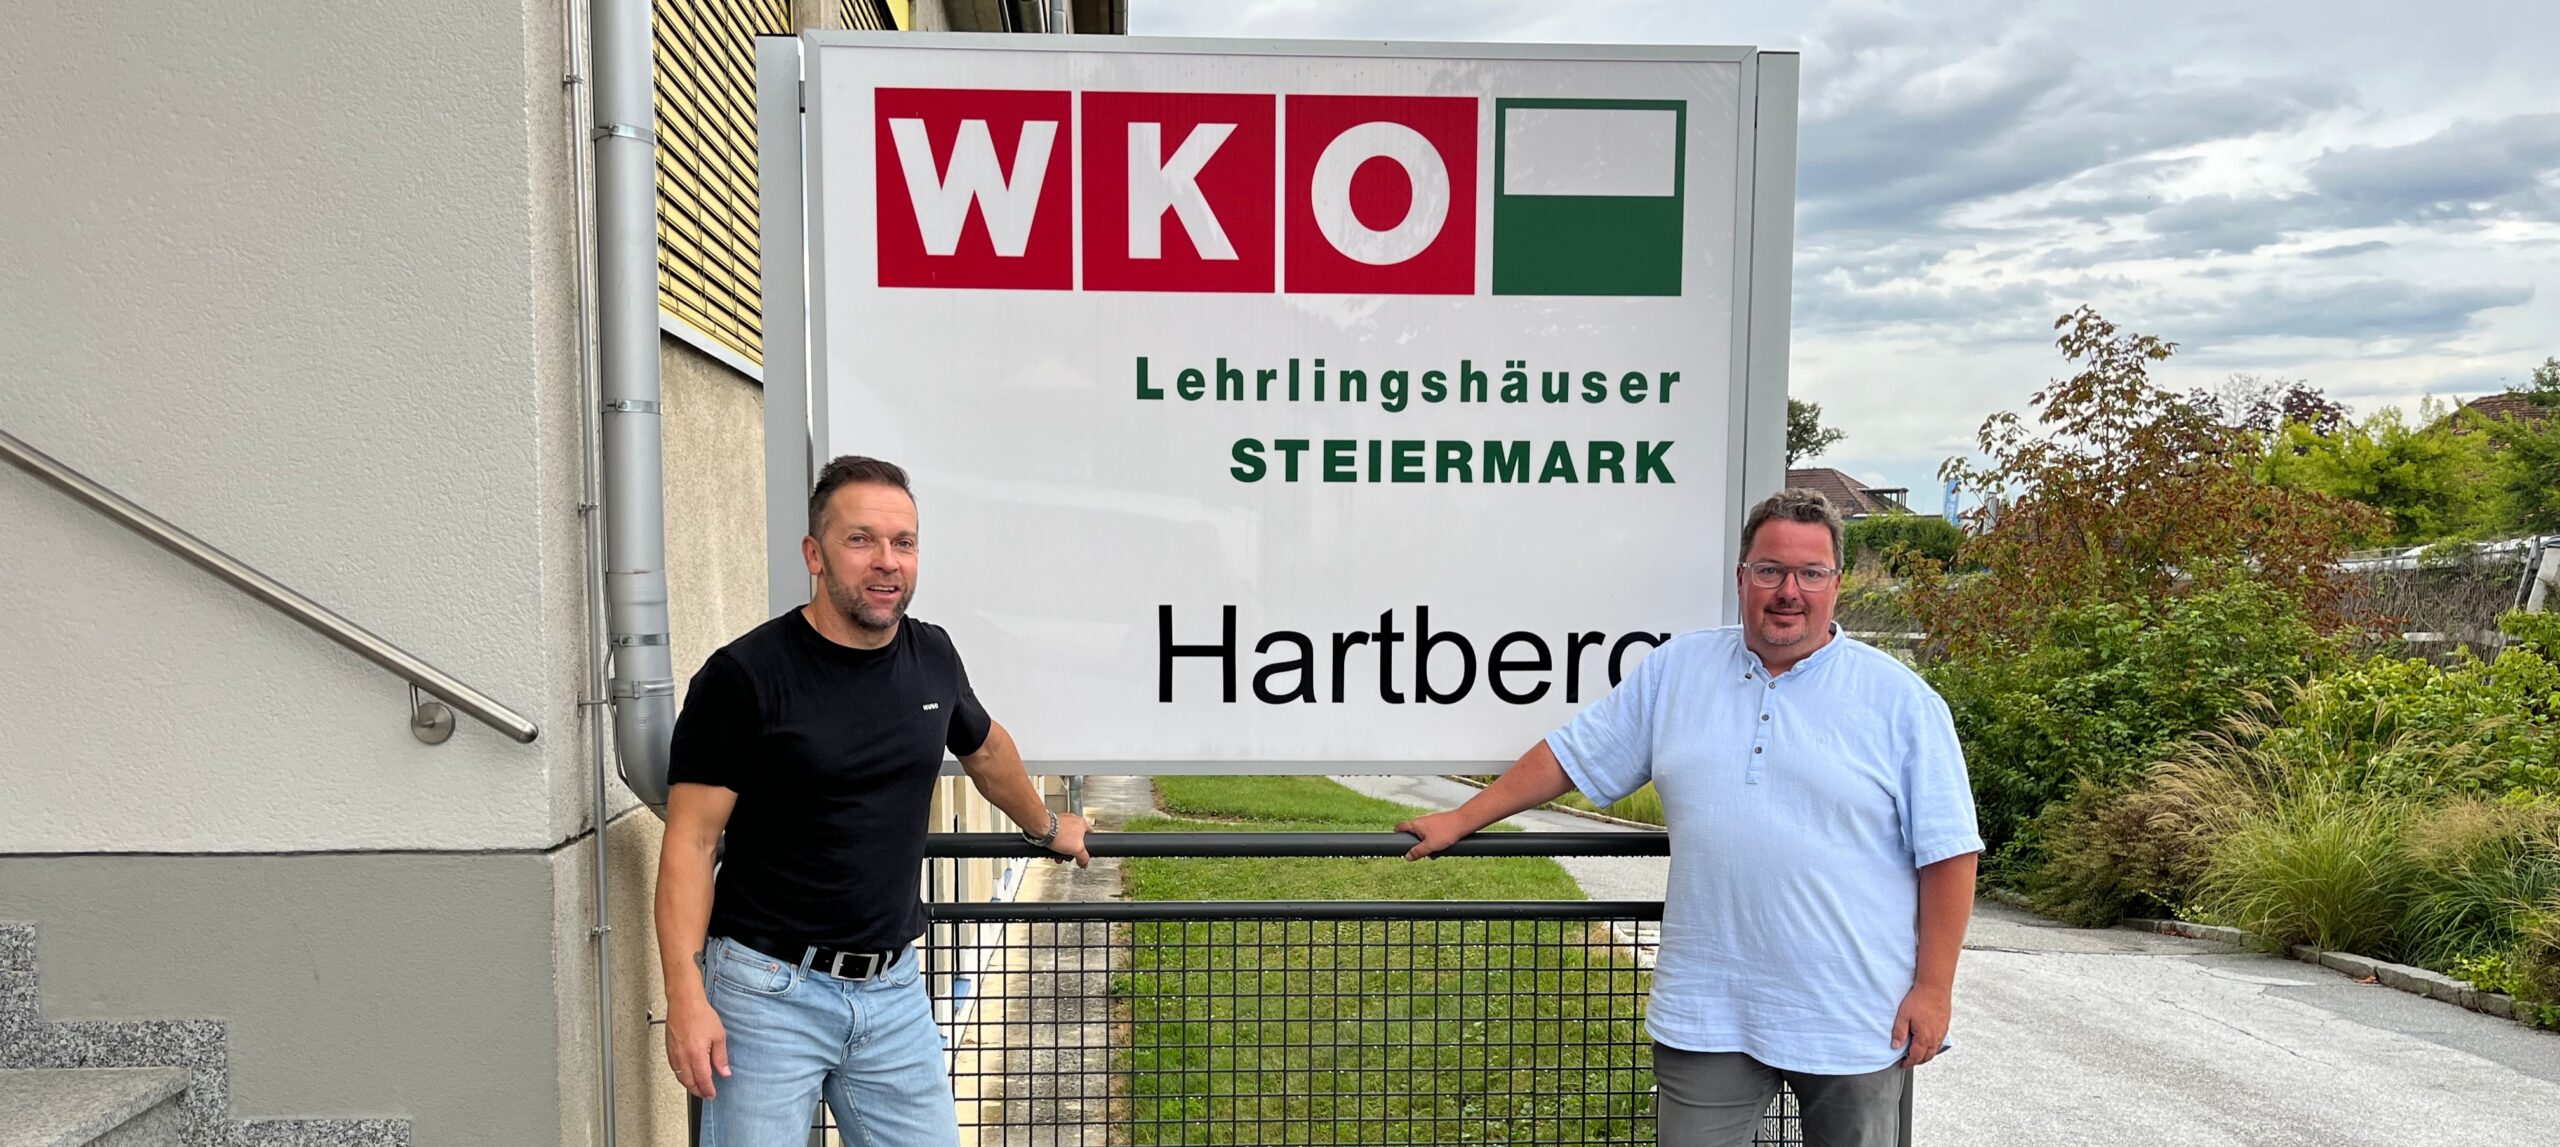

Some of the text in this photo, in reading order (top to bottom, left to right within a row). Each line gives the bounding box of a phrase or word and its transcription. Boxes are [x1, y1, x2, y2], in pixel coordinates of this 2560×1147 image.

[888, 117, 1451, 266] WKO
[1136, 356, 1682, 413] Lehrlingshäuser
[1229, 437, 1678, 484] STEIERMARK
